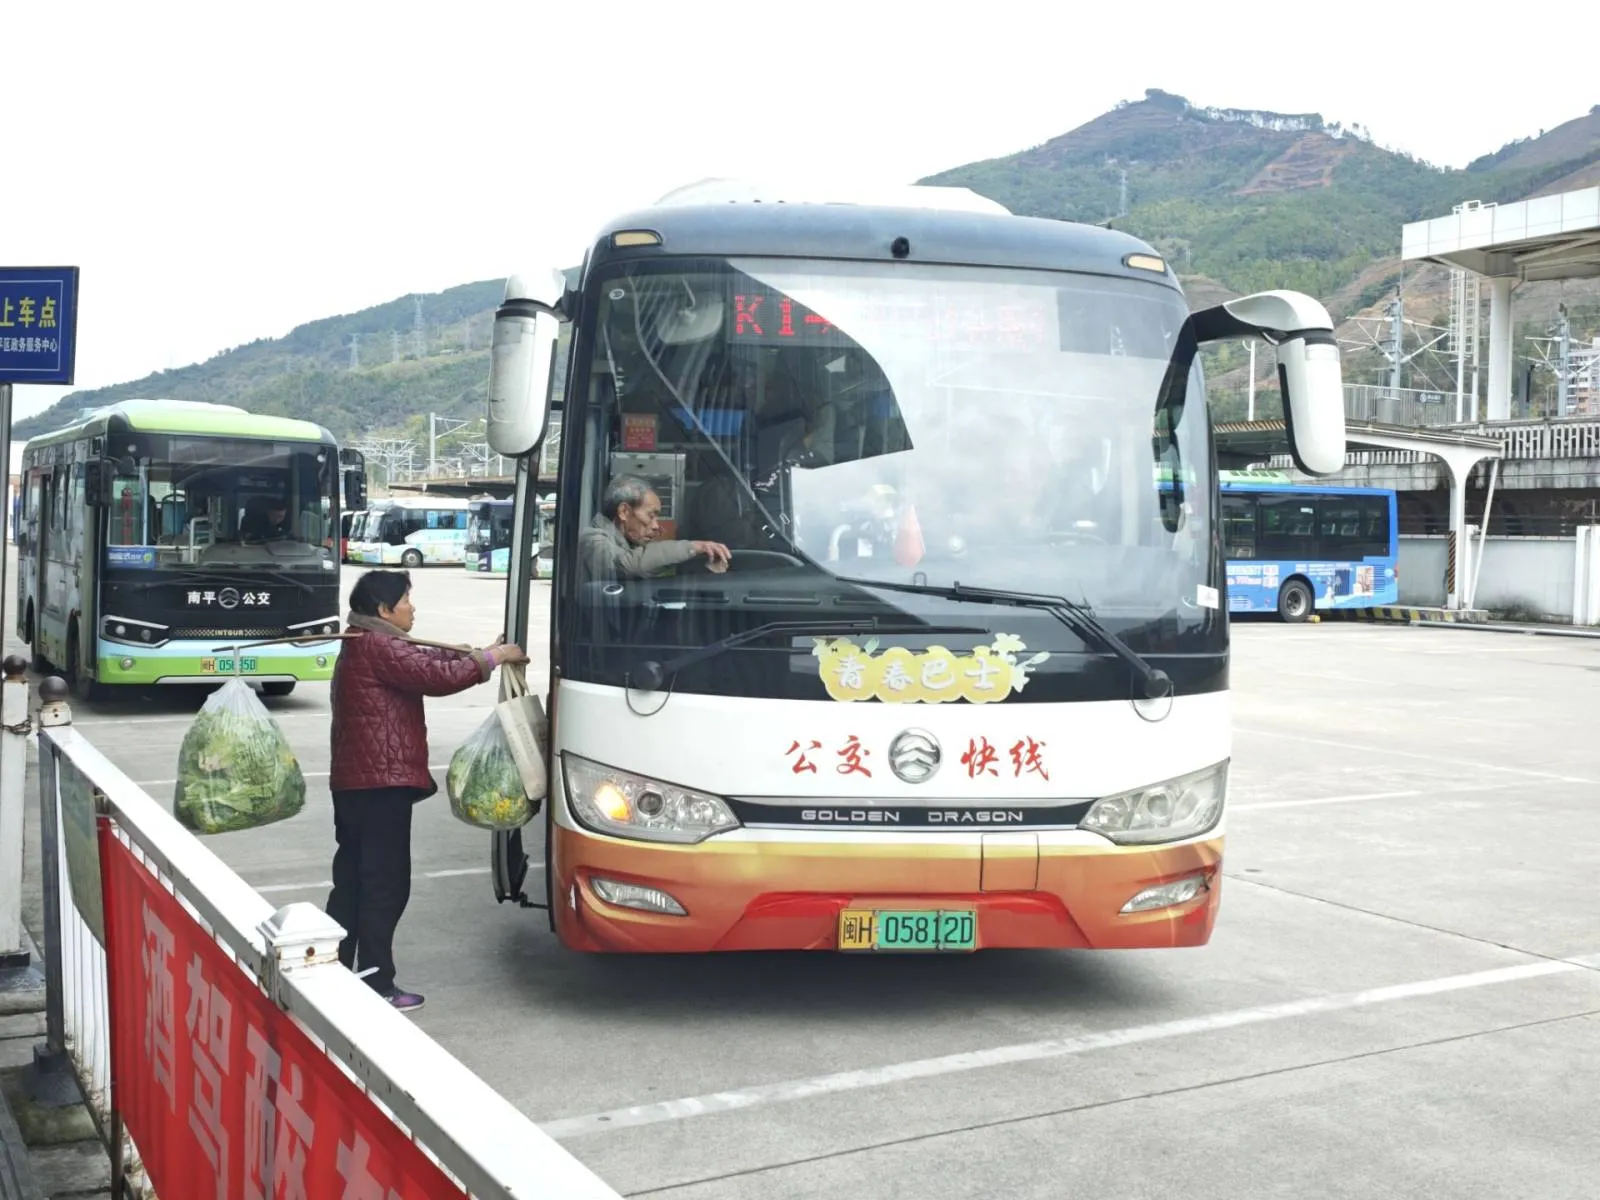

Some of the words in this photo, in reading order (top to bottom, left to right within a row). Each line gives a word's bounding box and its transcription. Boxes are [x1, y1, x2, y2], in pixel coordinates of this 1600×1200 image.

[0, 296, 57, 329] 上车点
[187, 591, 217, 605] 南平
[242, 592, 272, 605] 公交
[833, 655, 1003, 690] 青春巴士
[785, 735, 872, 778] 公交
[960, 736, 1050, 782] 快线
[801, 809, 900, 822] GOLDEN
[927, 810, 1024, 822] DRAGON
[142, 896, 408, 1200] 酒驾醉
